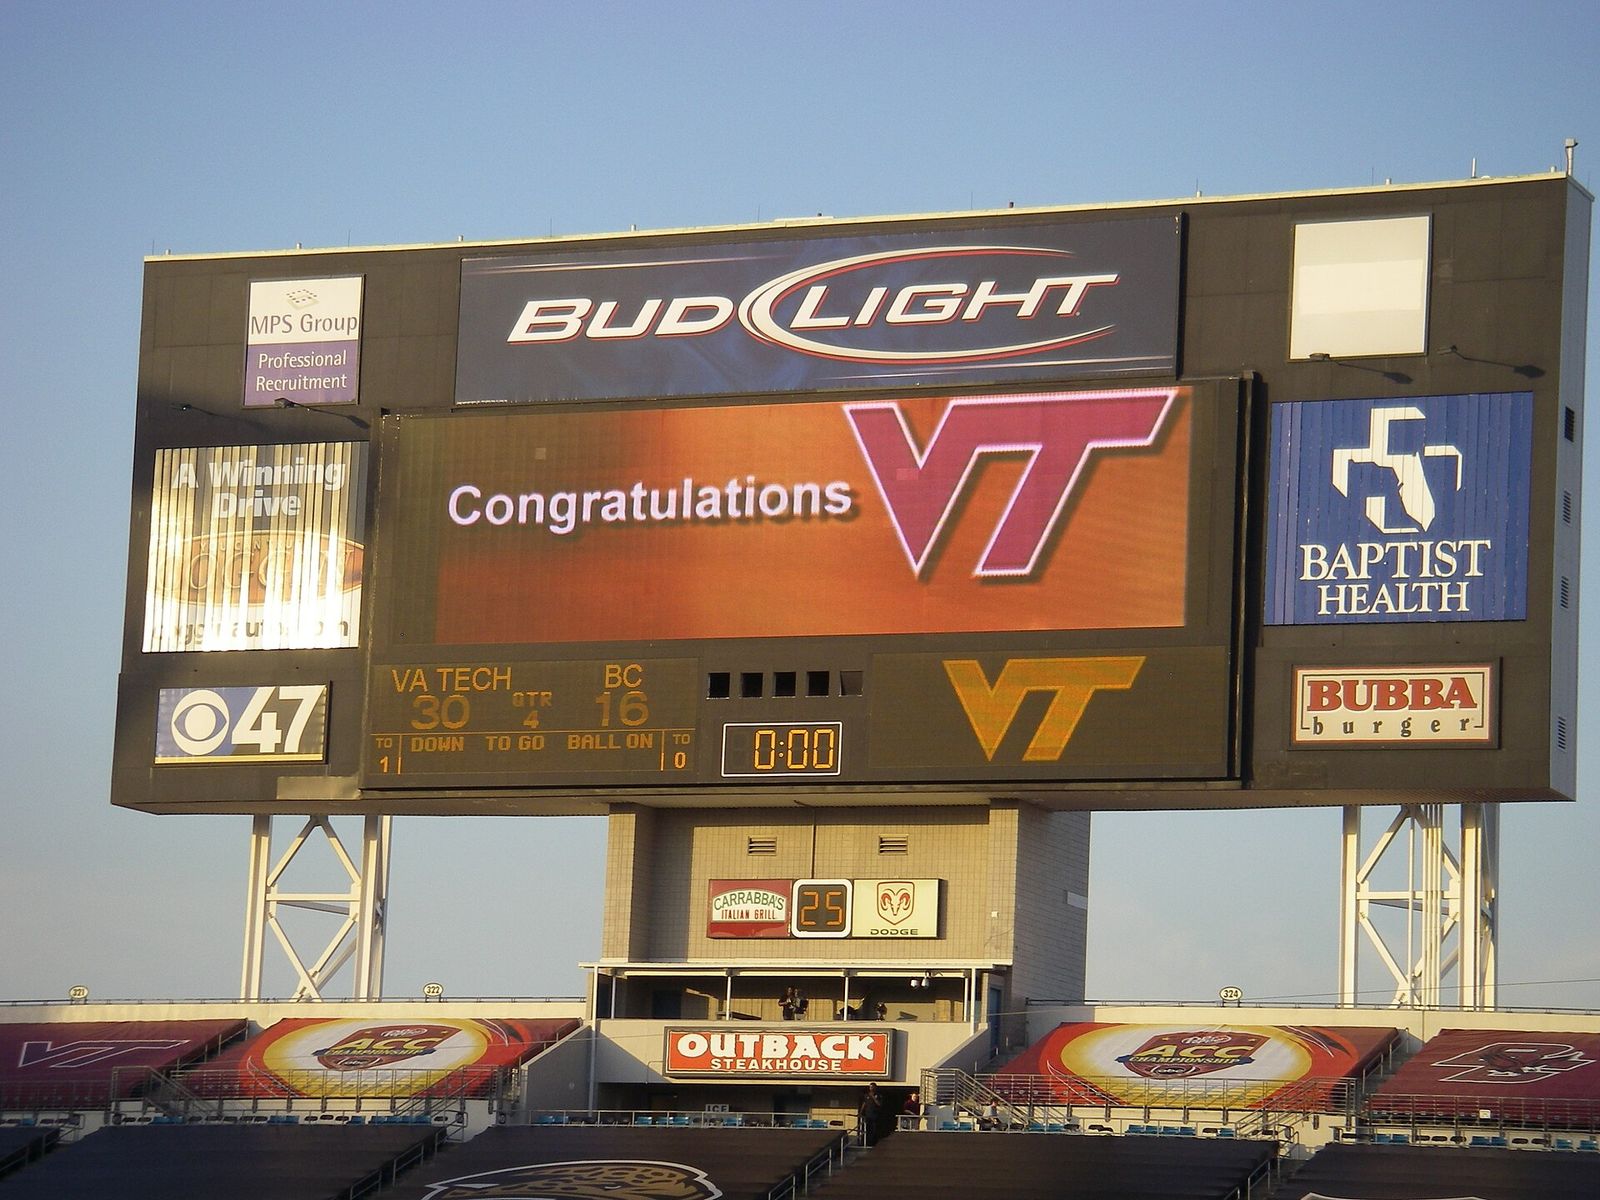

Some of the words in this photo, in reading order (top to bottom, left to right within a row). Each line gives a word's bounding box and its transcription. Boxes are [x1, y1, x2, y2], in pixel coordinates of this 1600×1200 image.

[505, 296, 735, 344] BUD
[789, 273, 1119, 330] LIGHT
[251, 314, 293, 335] MPS
[300, 313, 358, 336] Group
[258, 349, 347, 369] Professional
[256, 374, 348, 392] Recruitment
[171, 462, 199, 489] A
[208, 457, 347, 492] Winning
[211, 489, 302, 519] Drive
[447, 474, 853, 536] Congratulations
[1299, 539, 1492, 581] BAPTIST
[1316, 581, 1471, 616] HEALTH
[391, 668, 429, 693] VA
[436, 666, 513, 692] TECH
[604, 663, 643, 689] BC
[1306, 676, 1478, 712] BUBBA
[231, 684, 327, 753] 47
[410, 693, 470, 730] 30
[595, 690, 649, 727] 16
[523, 710, 540, 729] 4
[1312, 715, 1472, 738] burger
[376, 737, 392, 749] TO
[411, 736, 465, 752] DOWN
[486, 735, 511, 751] TO
[518, 735, 545, 751] GO
[567, 734, 621, 750] BALL
[626, 733, 653, 749] ON
[673, 733, 691, 745] TO
[754, 728, 836, 770] 0:00
[379, 756, 390, 773] 1
[673, 752, 687, 769] 0
[713, 890, 785, 912] CARRABBA'S
[800, 891, 843, 926] 25
[721, 909, 750, 920] ITALIAN
[754, 909, 776, 920] GRILL
[870, 928, 919, 936] DODGE
[426, 985, 440, 994] 322
[1223, 989, 1239, 998] 324
[331, 1037, 443, 1050] ACC
[676, 1033, 875, 1061] OUTBACK
[1133, 1044, 1254, 1058] ACC
[710, 1057, 843, 1071] STEAKHOUSE
[1128, 1055, 1241, 1065] CHAMPIONSHIP
